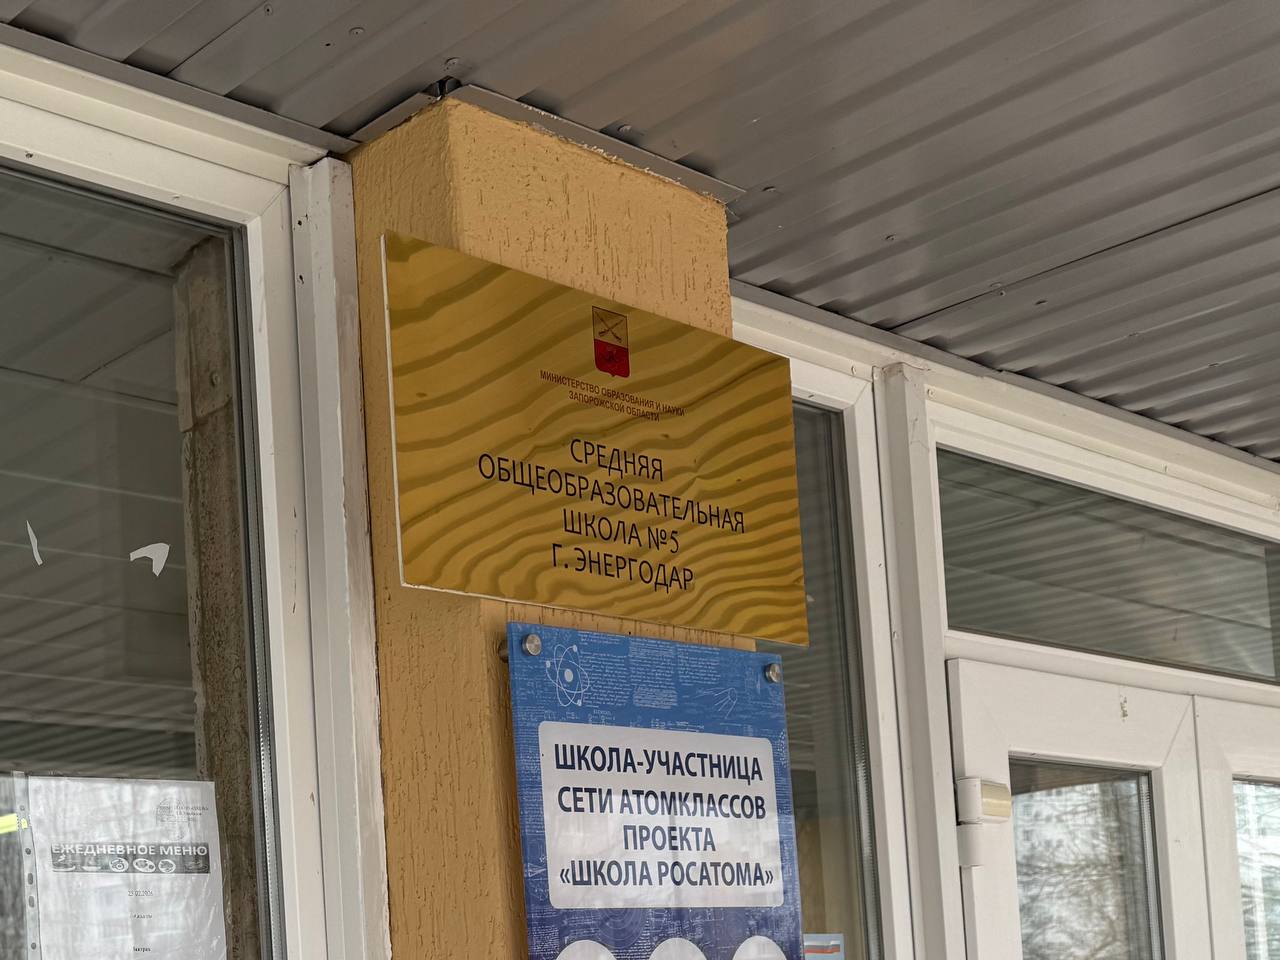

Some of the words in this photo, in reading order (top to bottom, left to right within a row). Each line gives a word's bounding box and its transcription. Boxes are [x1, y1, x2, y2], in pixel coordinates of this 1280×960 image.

[540, 370, 600, 394] МИНИСТЕРСТВО
[601, 387, 654, 409] ОБРАЗОВАНИЯ
[655, 401, 661, 411] И
[663, 403, 685, 416] НАУКИ
[568, 391, 625, 412] ЗАПОРОЖСКОЙ
[626, 407, 659, 421] ОБЛАСТИ
[570, 438, 664, 482] СРЕДНЯЯ
[478, 453, 745, 533] ОБЩЕОБРАЗОВАТЕЛЬНАЯ
[563, 508, 642, 547] ШКОЛА
[648, 526, 679, 553] №5
[552, 543, 569, 568] Г.
[574, 548, 694, 593] ЭНЕРГОДАР
[554, 743, 763, 786] ШКОЛА-УЧАСТНИЦА
[557, 786, 614, 813] СЕТИ
[619, 789, 766, 820] АТОМКЛАССОВ
[52, 844, 156, 856] ЕЖЕДНЕВНОЕ
[160, 845, 207, 856] МЕНЮ
[623, 825, 715, 851] ПРОЕКТА
[560, 860, 653, 886] «ШКОЛА
[657, 860, 774, 887] РОСАТОМА»
